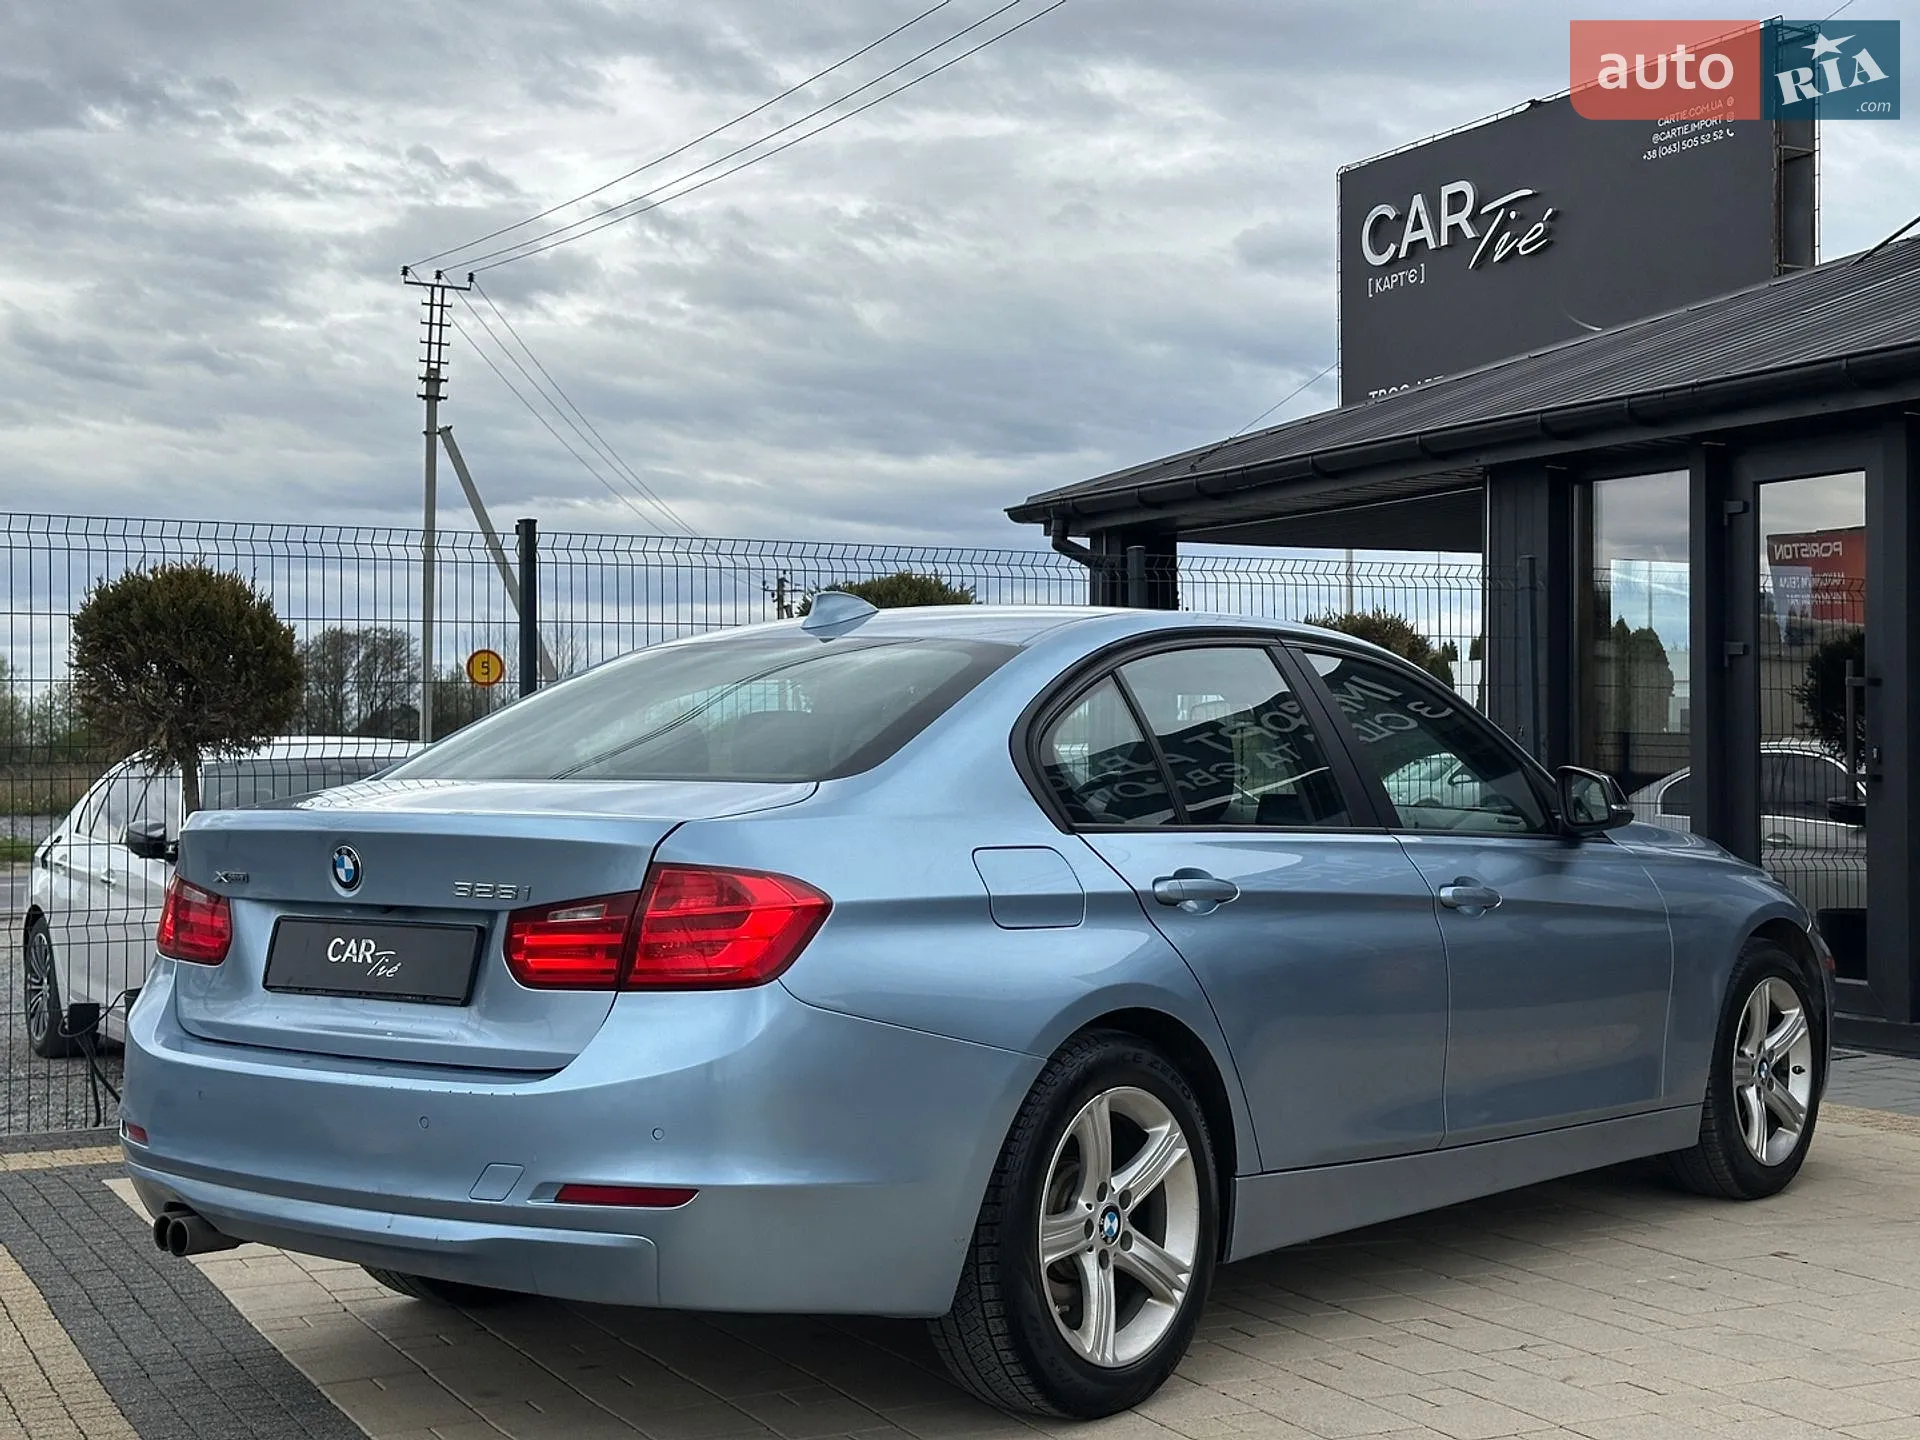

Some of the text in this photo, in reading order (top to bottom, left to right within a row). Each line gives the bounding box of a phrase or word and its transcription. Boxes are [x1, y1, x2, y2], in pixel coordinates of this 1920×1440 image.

[1642, 149, 1658, 160] +38
[1681, 136, 1699, 150] 505
[1700, 133, 1711, 144] 52
[1712, 129, 1724, 141] 52
[481, 661, 491, 676] 5
[327, 937, 376, 963] CAR
